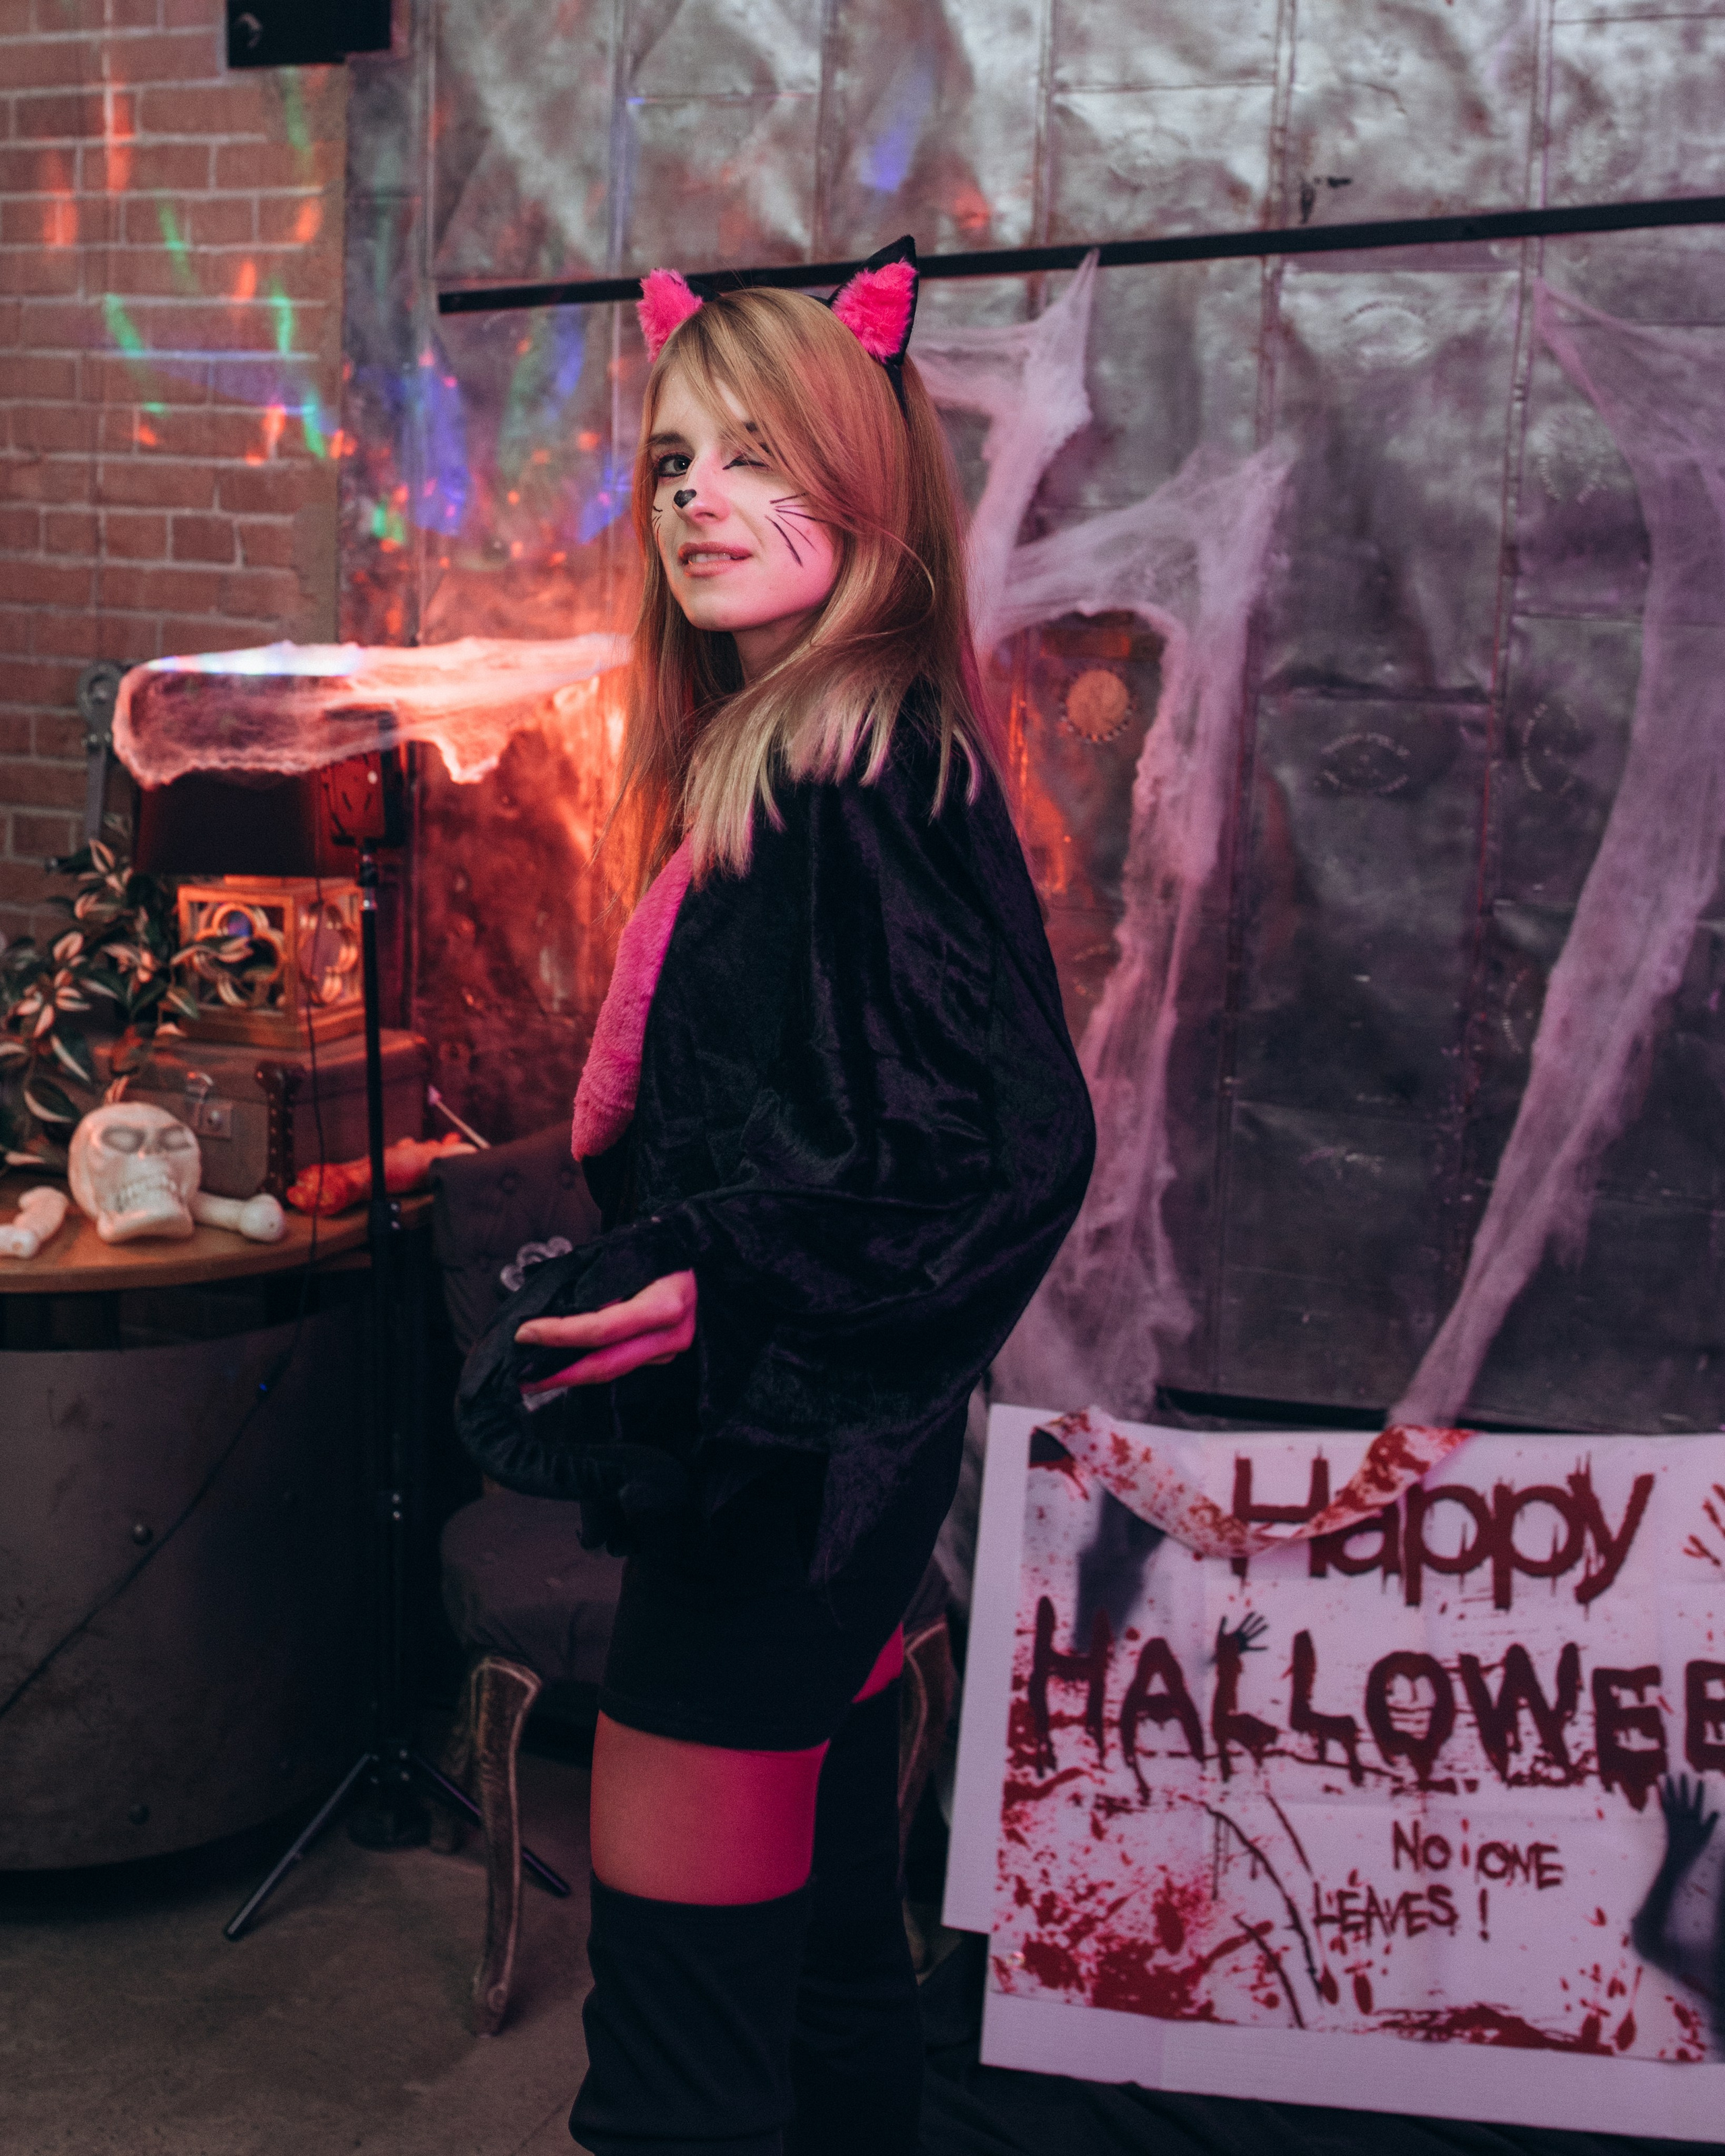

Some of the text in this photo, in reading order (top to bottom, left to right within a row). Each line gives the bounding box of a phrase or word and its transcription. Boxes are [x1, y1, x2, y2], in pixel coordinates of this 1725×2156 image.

[1231, 1449, 1655, 1612] Happy
[1393, 1820, 1563, 1889] NO ONE
